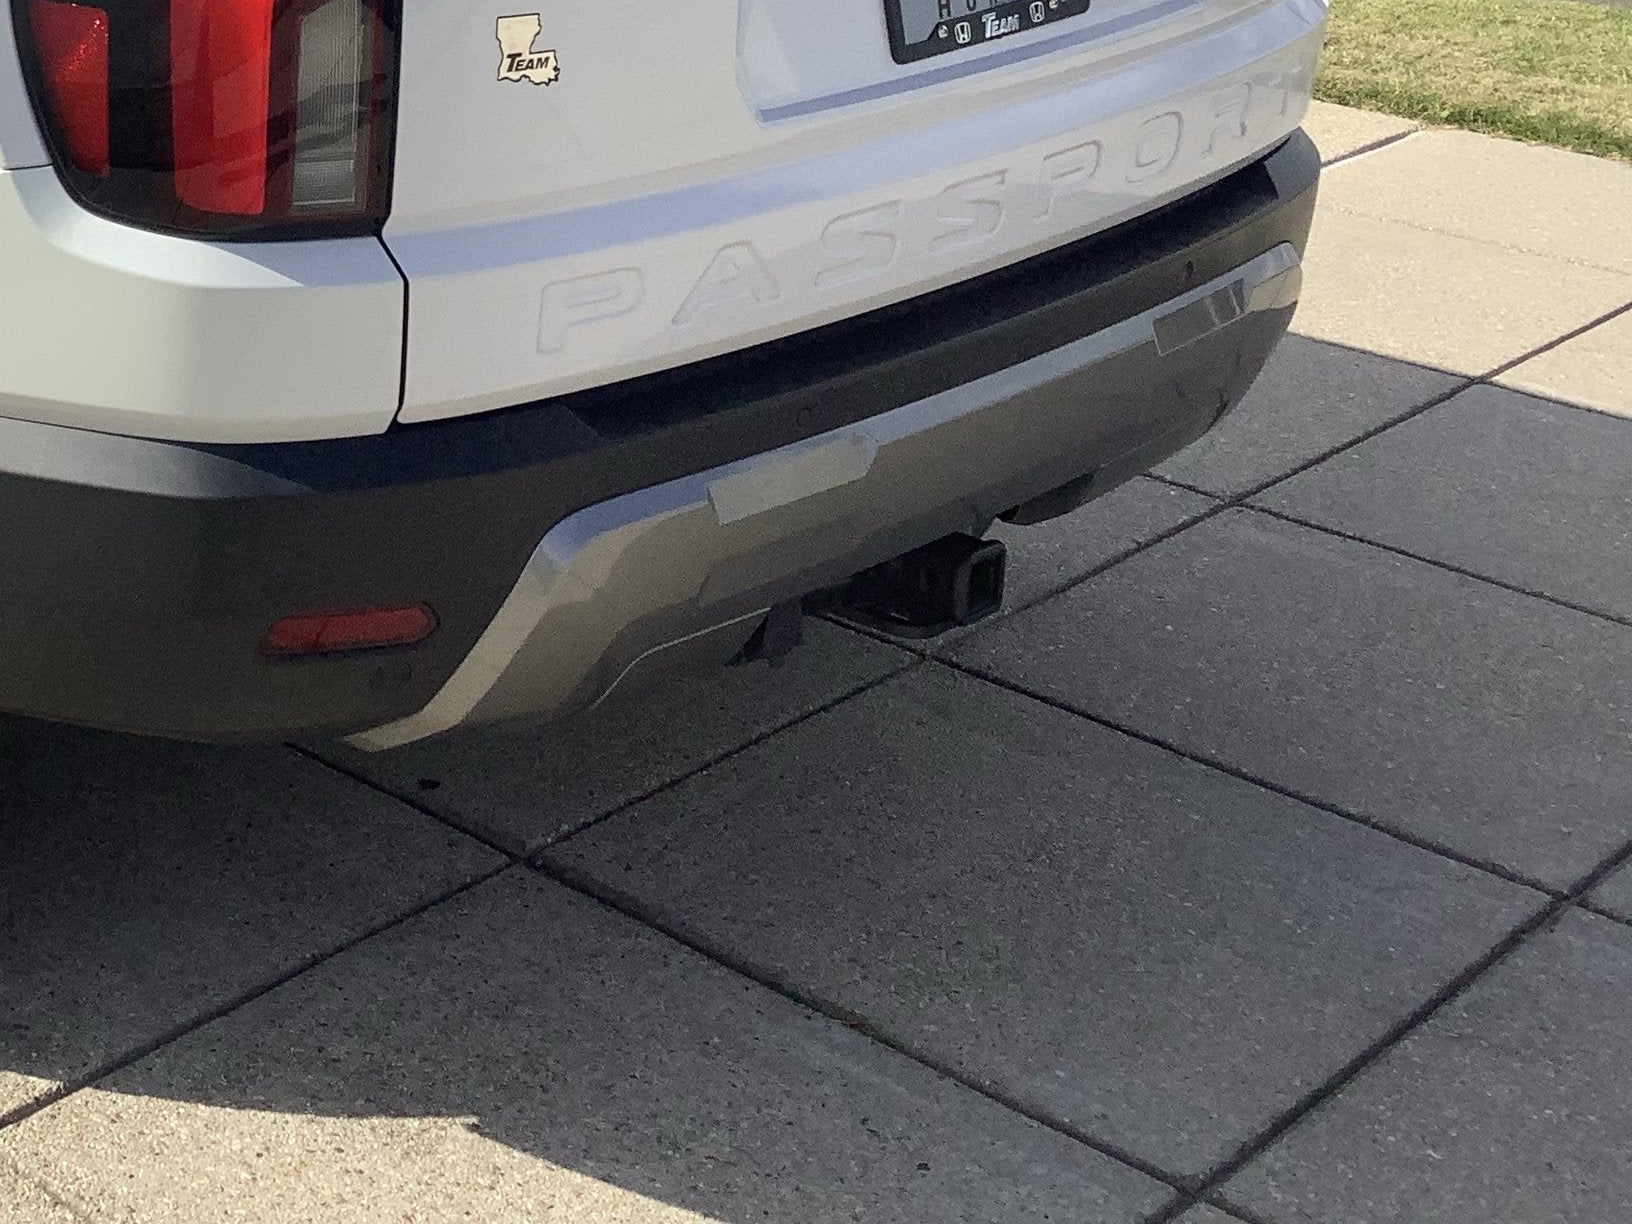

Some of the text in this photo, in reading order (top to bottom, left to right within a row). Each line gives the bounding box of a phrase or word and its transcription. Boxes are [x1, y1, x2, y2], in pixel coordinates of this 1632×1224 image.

[982, 12, 1020, 39] TEAM
[506, 52, 550, 73] TEAM
[536, 63, 1305, 356] PASSPORT
